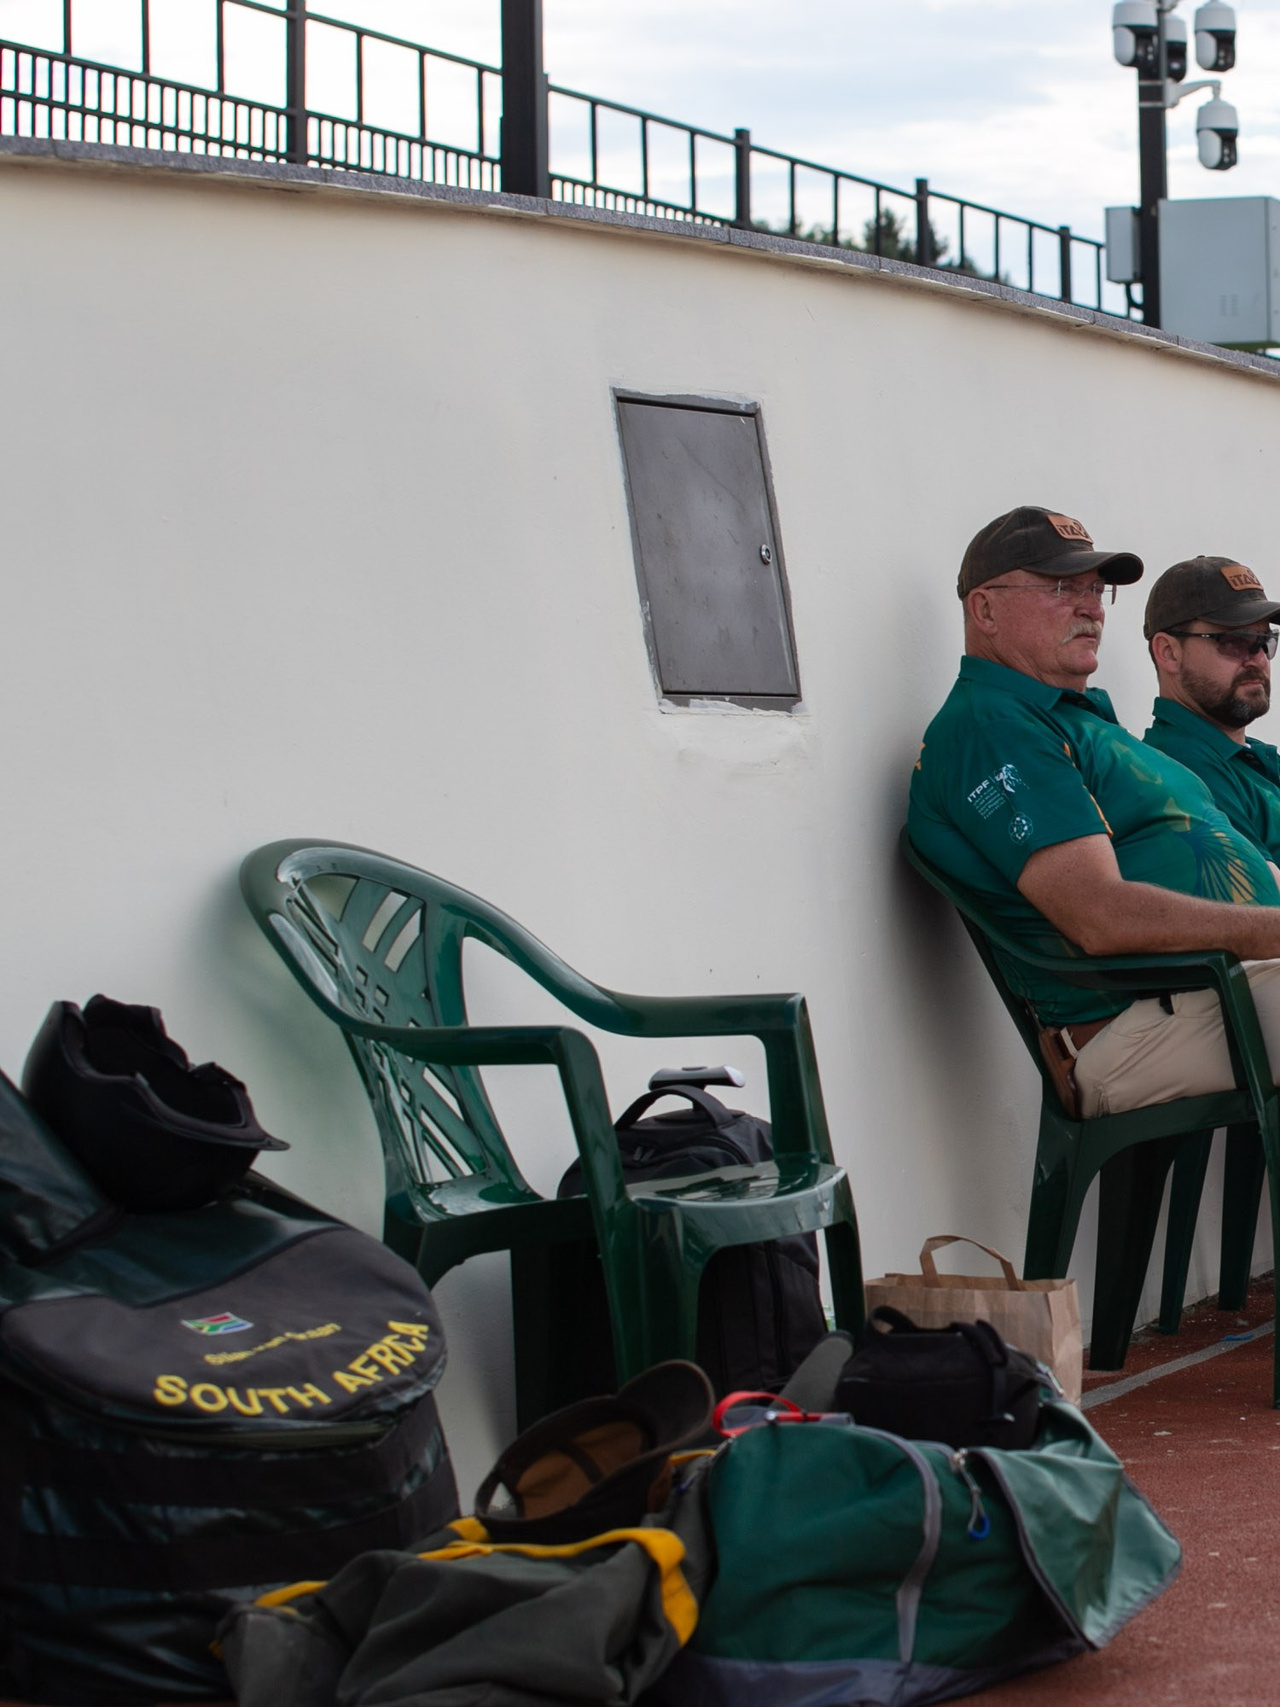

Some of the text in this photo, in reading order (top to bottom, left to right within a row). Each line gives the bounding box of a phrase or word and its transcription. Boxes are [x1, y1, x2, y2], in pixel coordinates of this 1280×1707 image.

[967, 779, 990, 803] ITPF
[153, 1374, 332, 1415] SOUTH
[332, 1320, 429, 1393] AFRICA
